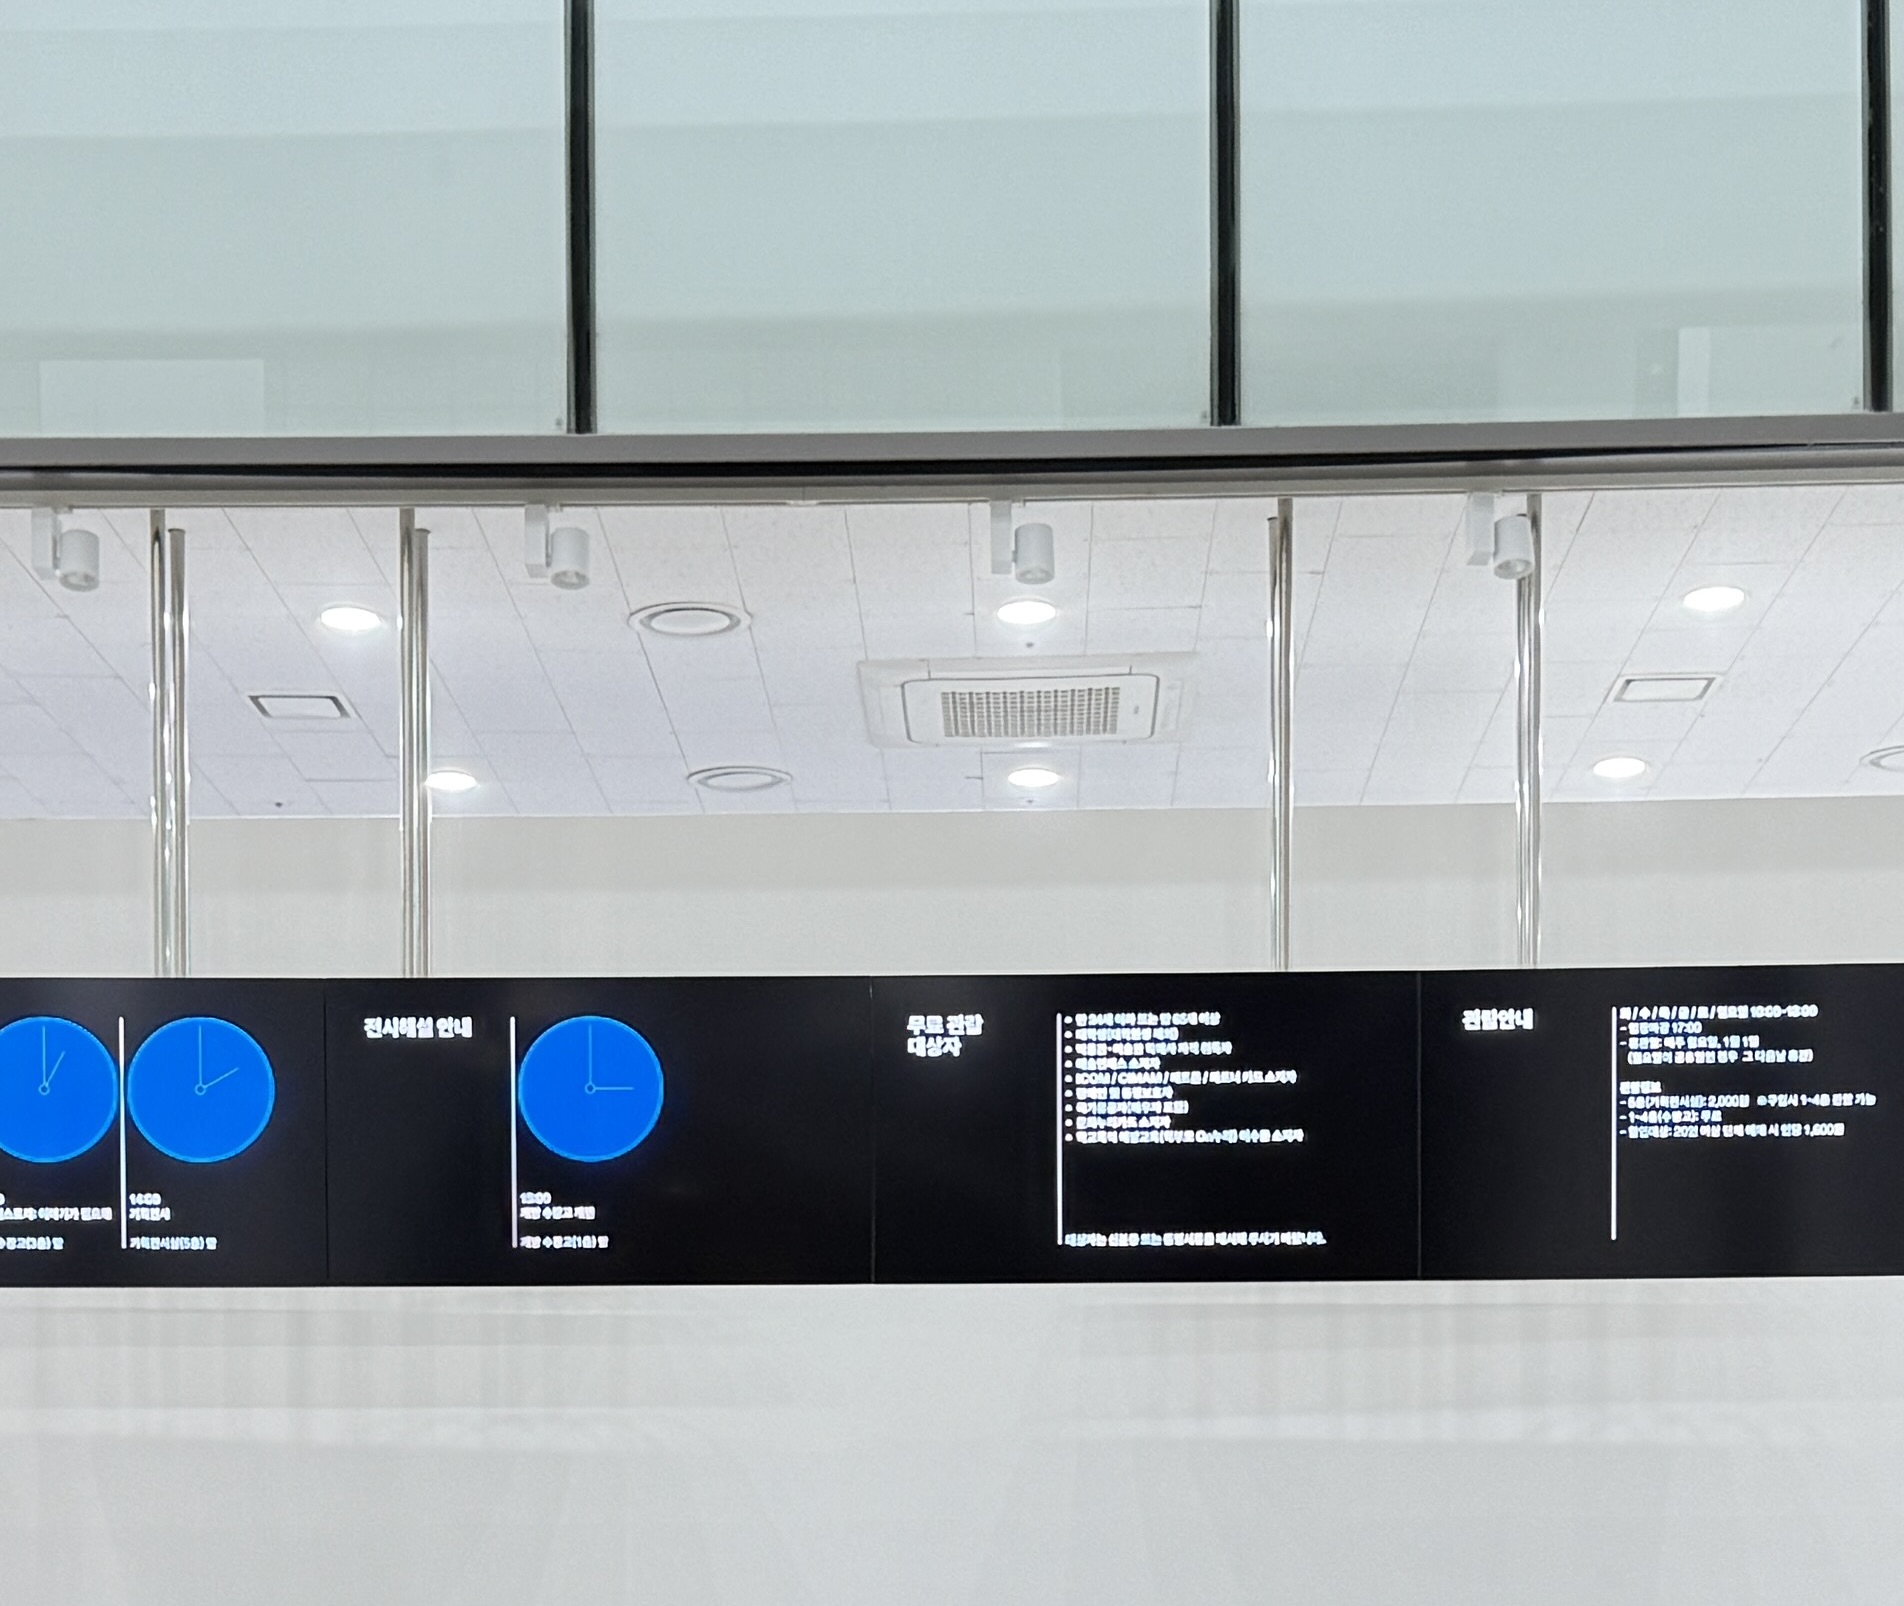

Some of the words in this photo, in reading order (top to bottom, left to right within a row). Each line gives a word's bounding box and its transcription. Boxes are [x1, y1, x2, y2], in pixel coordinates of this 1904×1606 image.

[436, 1017, 472, 1038] 안내
[907, 1016, 944, 1037] 무료
[907, 1036, 962, 1057] 대상자
